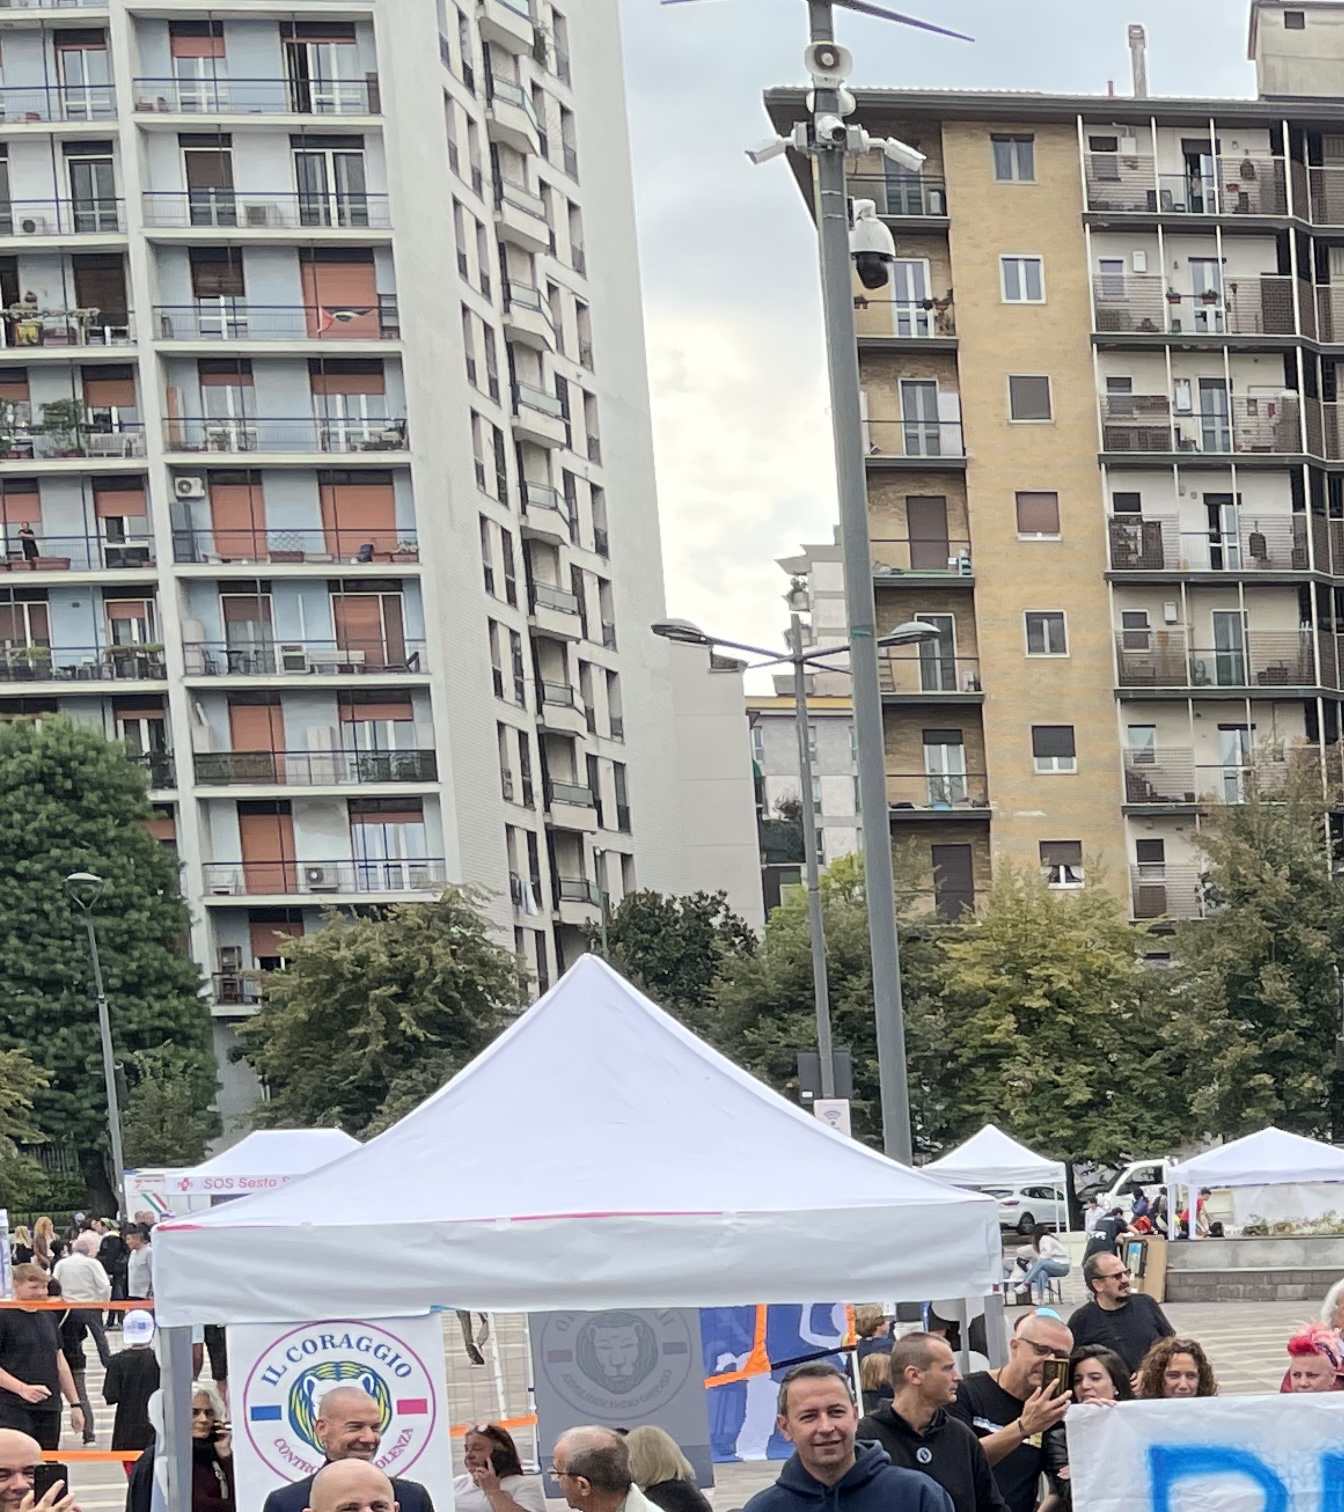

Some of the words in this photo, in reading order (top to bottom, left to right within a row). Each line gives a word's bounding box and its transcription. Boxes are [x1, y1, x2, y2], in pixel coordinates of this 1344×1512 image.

[203, 1177, 234, 1189] SOS
[238, 1176, 277, 1189] Sesto
[260, 1364, 288, 1387] IL
[285, 1333, 413, 1379] CORAGGIO
[375, 1426, 414, 1470] OLENZA
